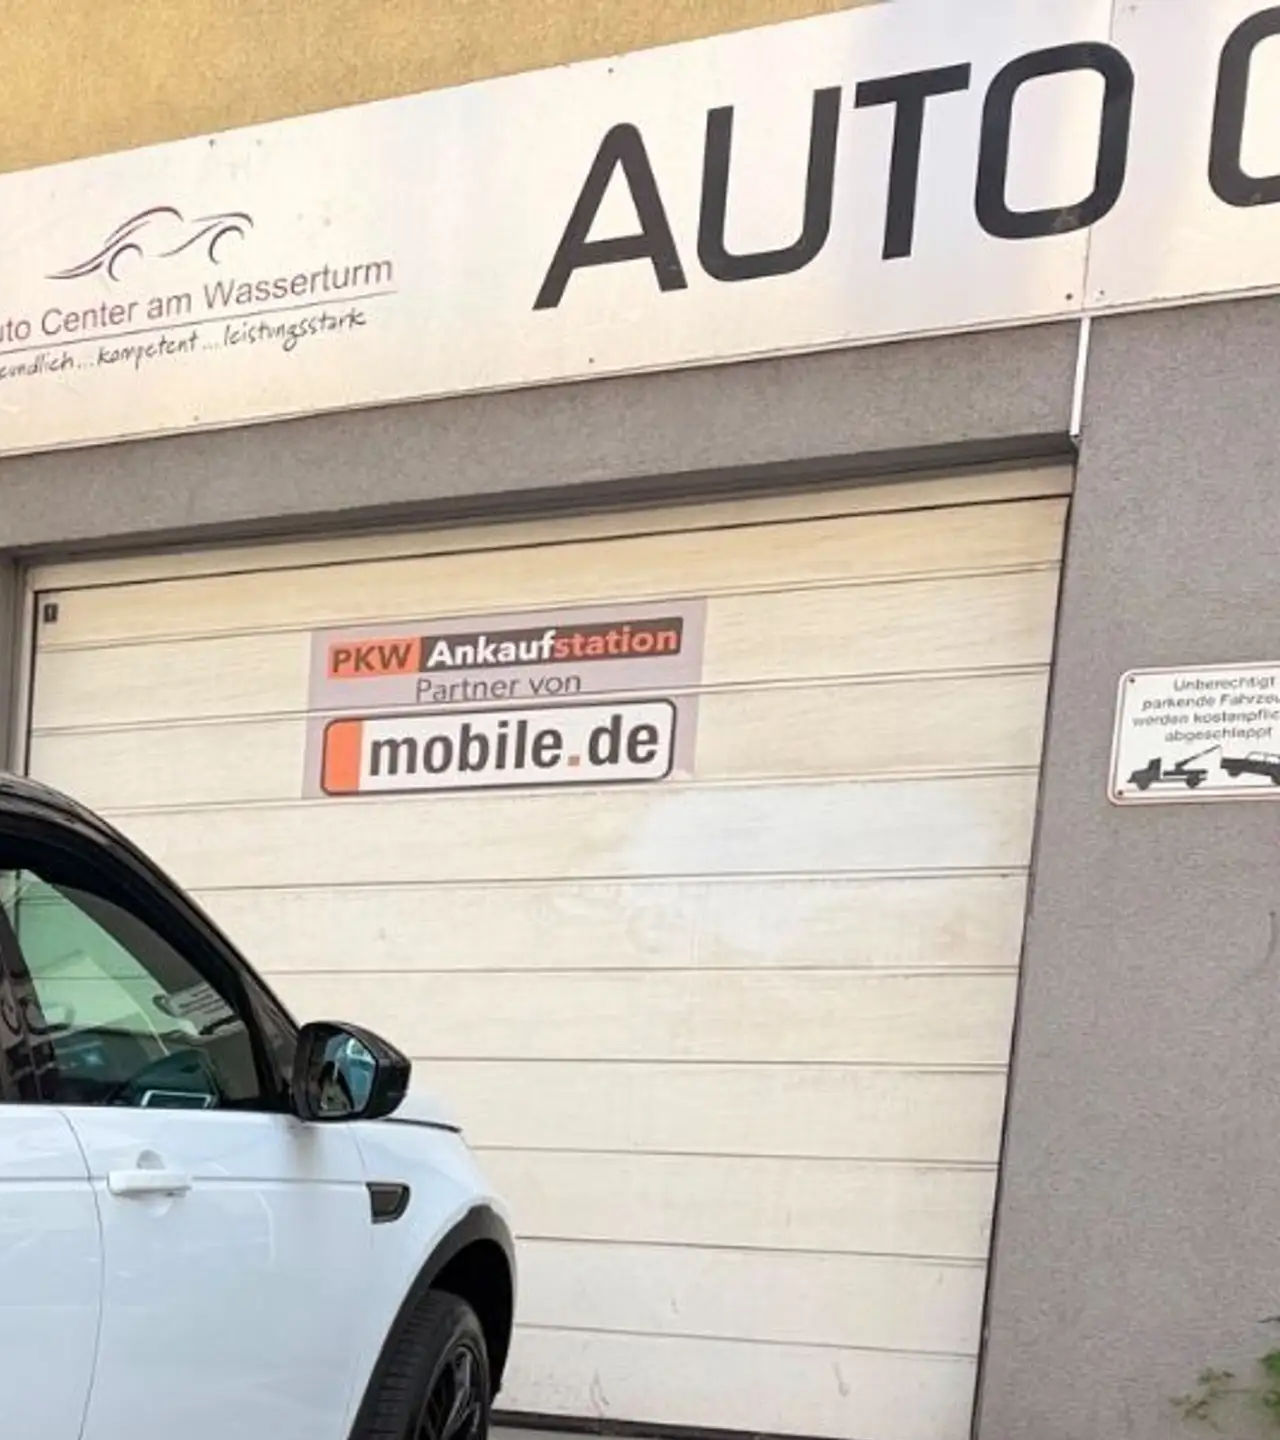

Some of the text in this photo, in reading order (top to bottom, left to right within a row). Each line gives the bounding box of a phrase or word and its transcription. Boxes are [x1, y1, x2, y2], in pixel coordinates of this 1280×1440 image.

[532, 41, 1135, 311] AUTO
[40, 301, 139, 336] Center
[146, 292, 192, 321] am
[203, 259, 392, 310] Wasserturm
[331, 625, 678, 674] PKW Ankaufstation
[416, 673, 582, 703] Partner von
[1141, 695, 1216, 711] parkende
[1173, 676, 1277, 692] Unberechtigt
[369, 714, 661, 777] mobile.de
